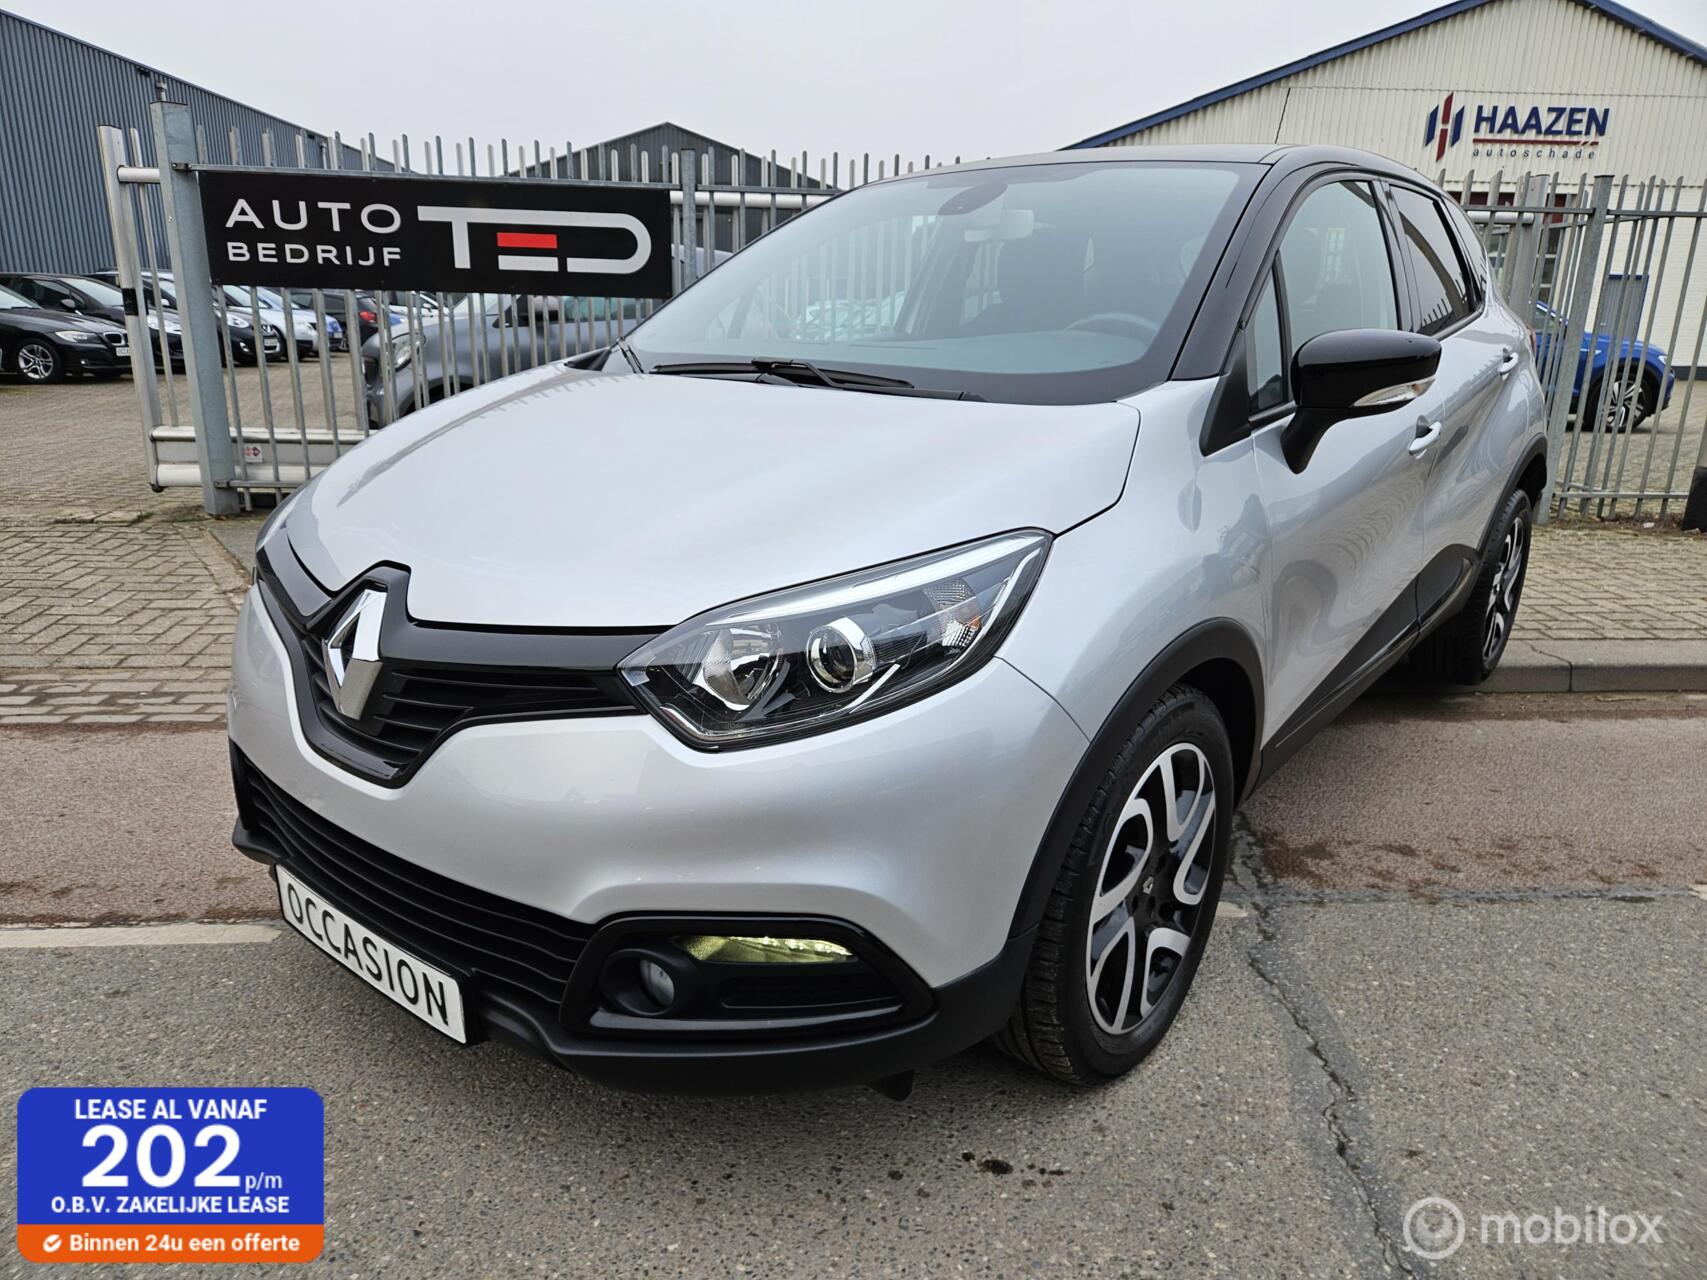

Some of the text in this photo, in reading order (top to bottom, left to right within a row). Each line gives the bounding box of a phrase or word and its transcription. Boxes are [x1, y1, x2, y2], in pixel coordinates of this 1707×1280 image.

[1473, 105, 1610, 136] HAAZEN
[1472, 148, 1595, 159] autoschade
[225, 198, 401, 234] AUTO
[226, 241, 401, 267] BEDRIJF
[417, 205, 652, 275] TED
[287, 882, 449, 1027] OCCASION
